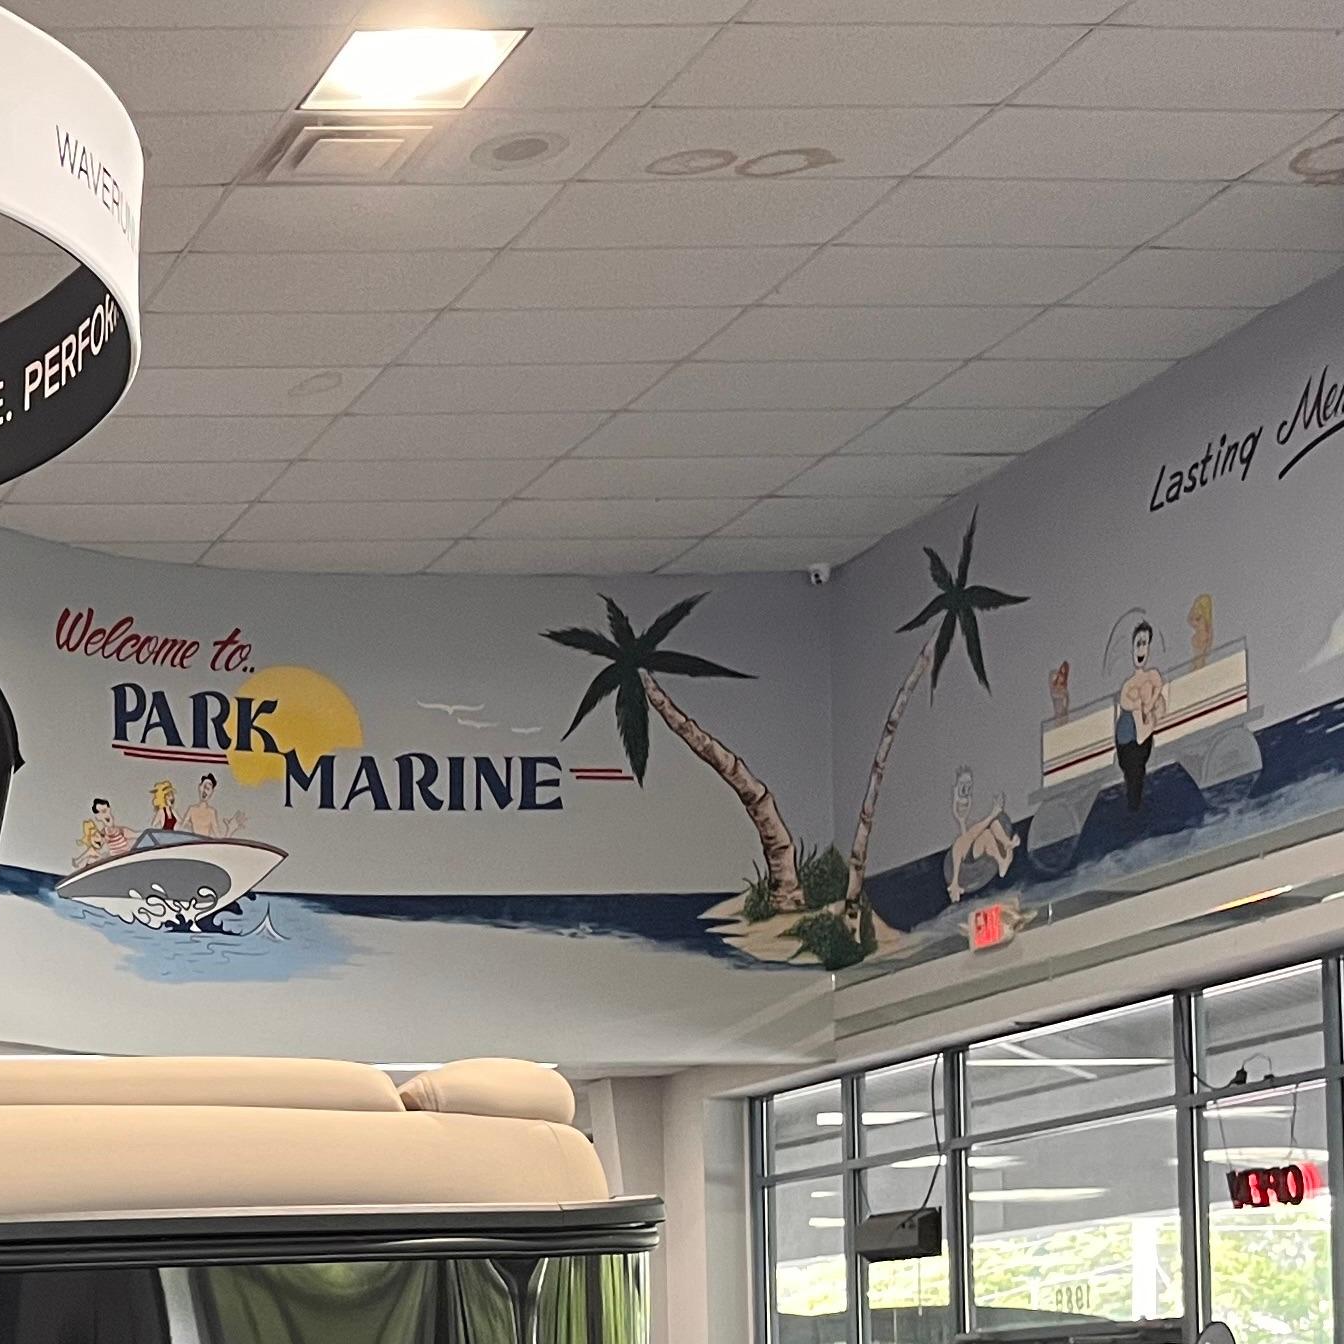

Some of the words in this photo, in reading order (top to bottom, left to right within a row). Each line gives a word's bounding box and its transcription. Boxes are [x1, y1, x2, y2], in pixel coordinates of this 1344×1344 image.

[1149, 424, 1264, 512] Lasting
[55, 607, 200, 669] Welcome
[111, 683, 286, 755] PARK
[282, 751, 564, 812] MARINE
